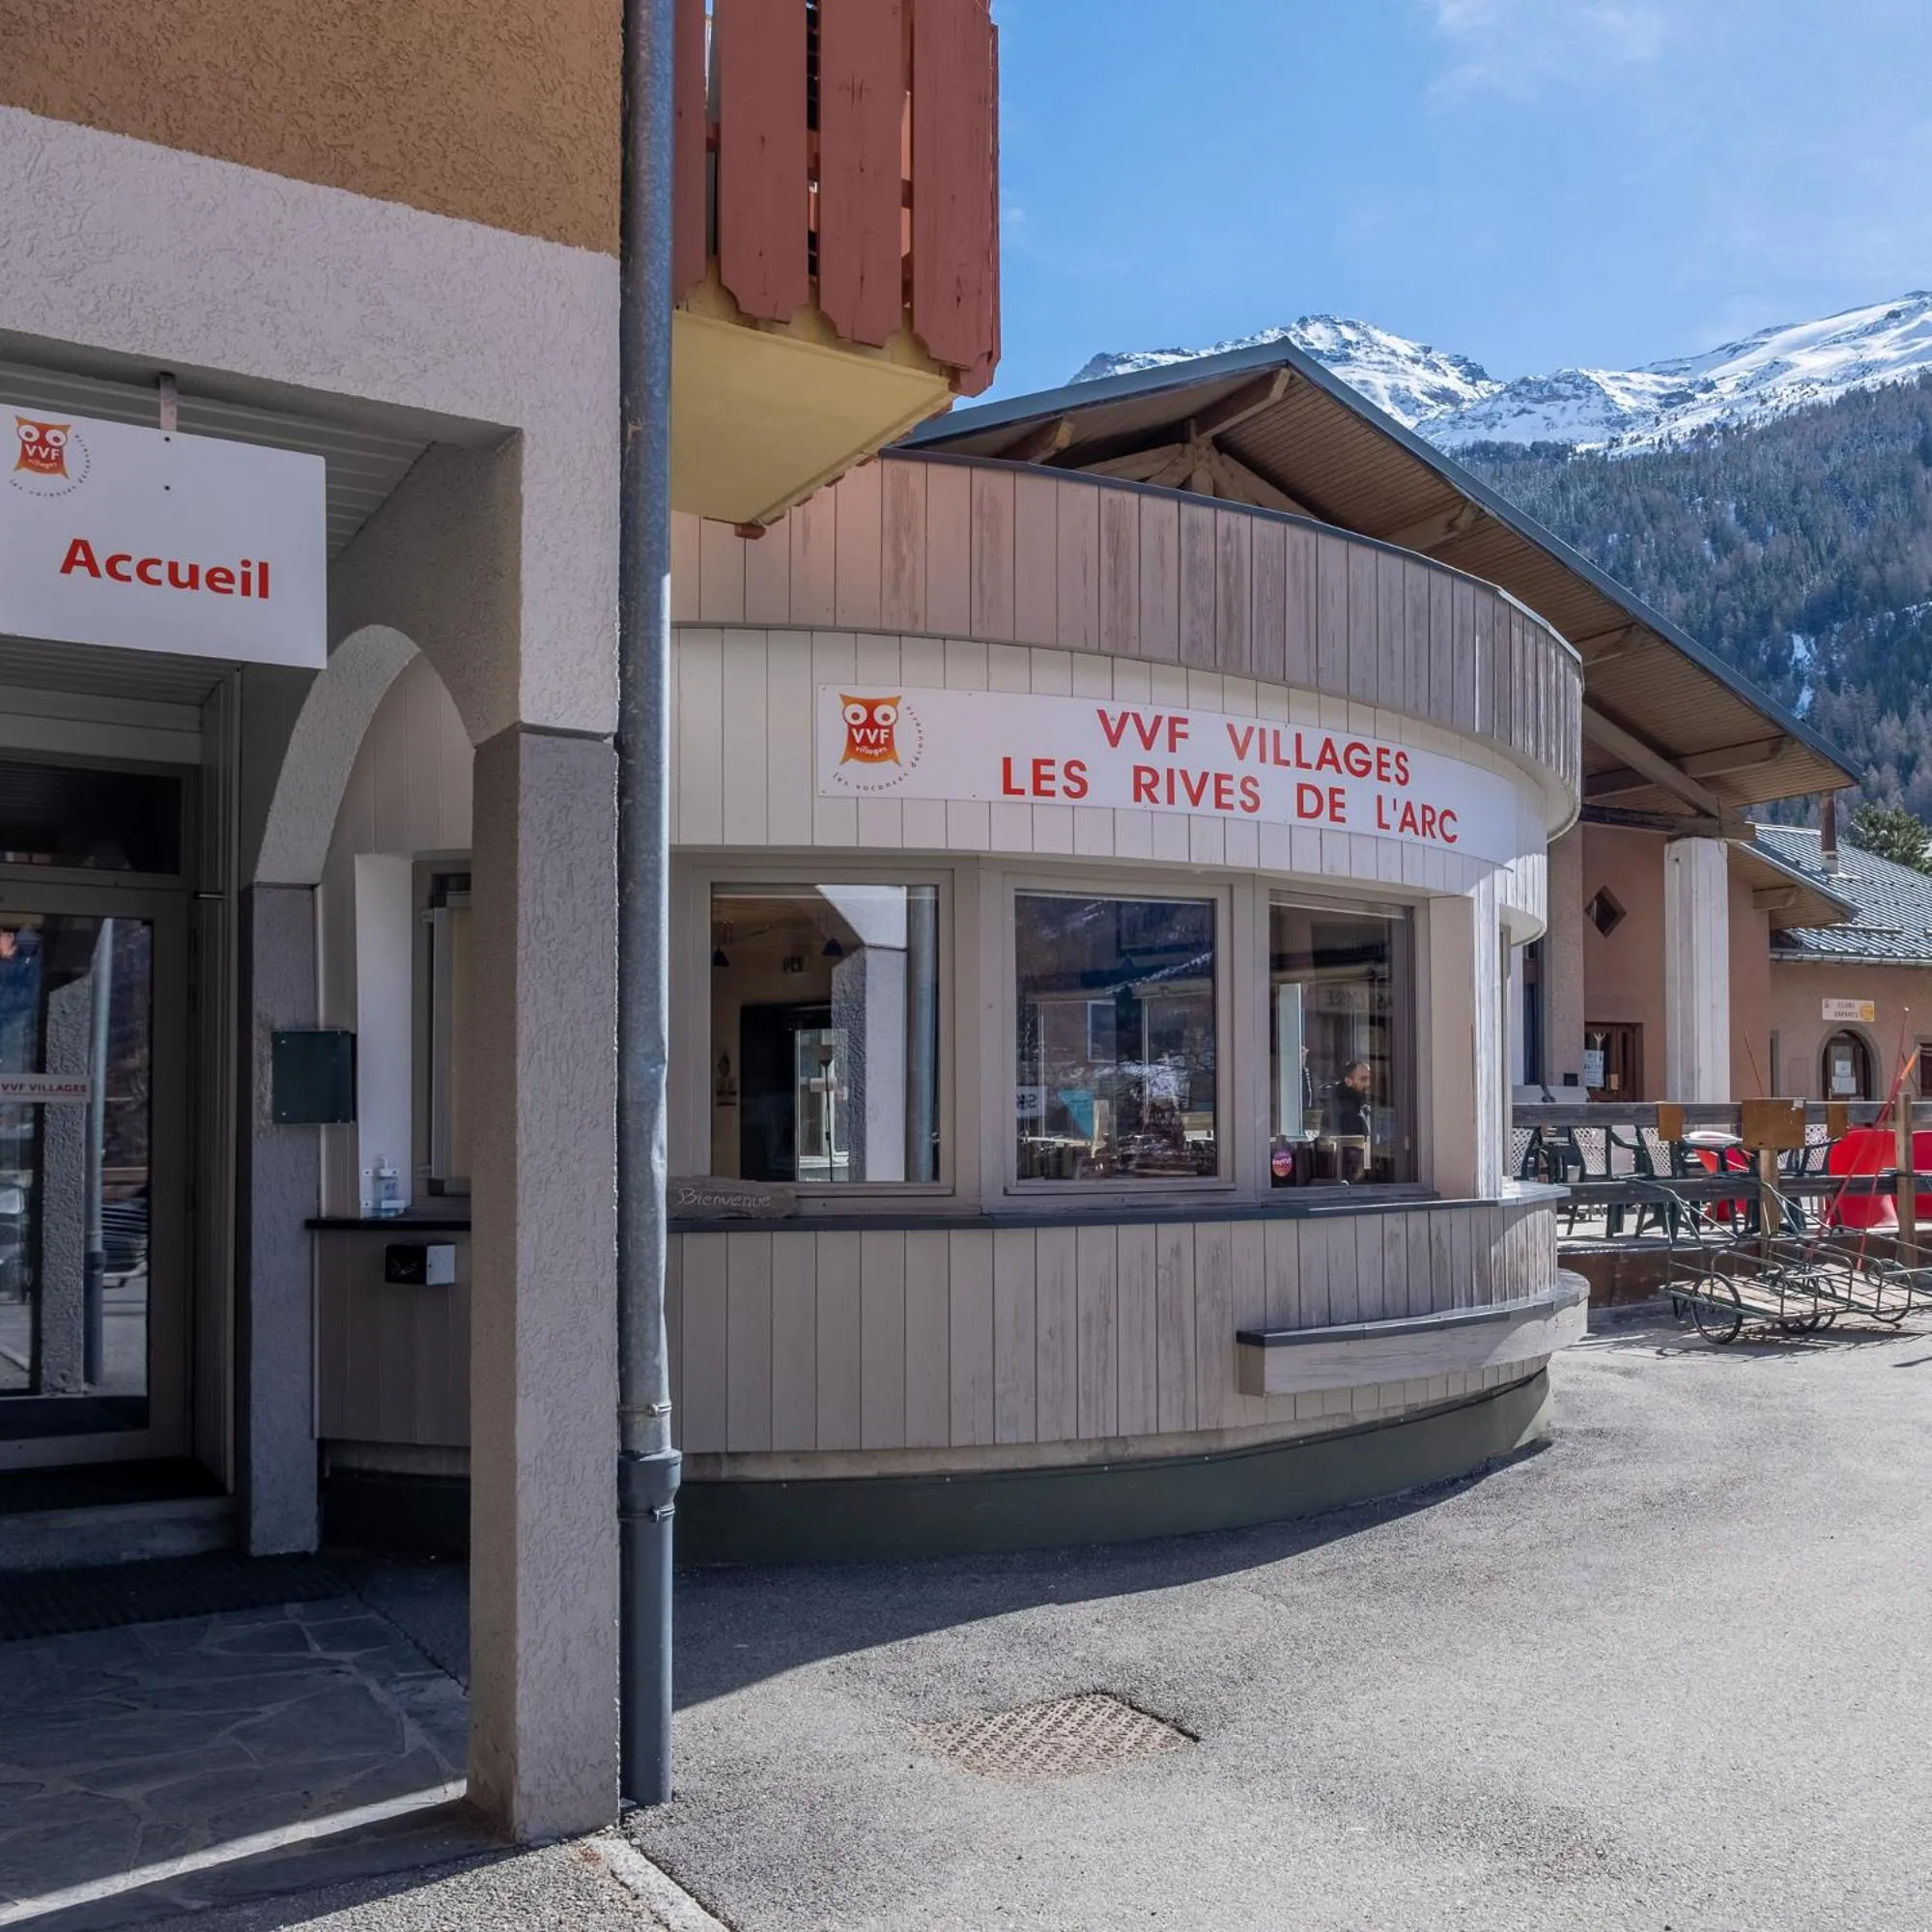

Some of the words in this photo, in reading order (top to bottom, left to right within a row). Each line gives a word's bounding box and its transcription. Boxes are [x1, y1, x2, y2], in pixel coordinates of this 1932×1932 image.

[25, 444, 60, 460] VVF
[60, 538, 270, 599] Accueil
[851, 727, 890, 744] VVF
[1096, 708, 1189, 753] VVF
[1226, 723, 1410, 786] VILLAGES
[1002, 756, 1089, 800] LES
[1133, 764, 1261, 813] RIVES
[1296, 781, 1347, 824] DE
[1377, 794, 1459, 843] L'ARC
[1, 1082, 25, 1092] VVF
[30, 1083, 87, 1093] VILLAGES
[678, 1186, 772, 1207] Bienvenue
